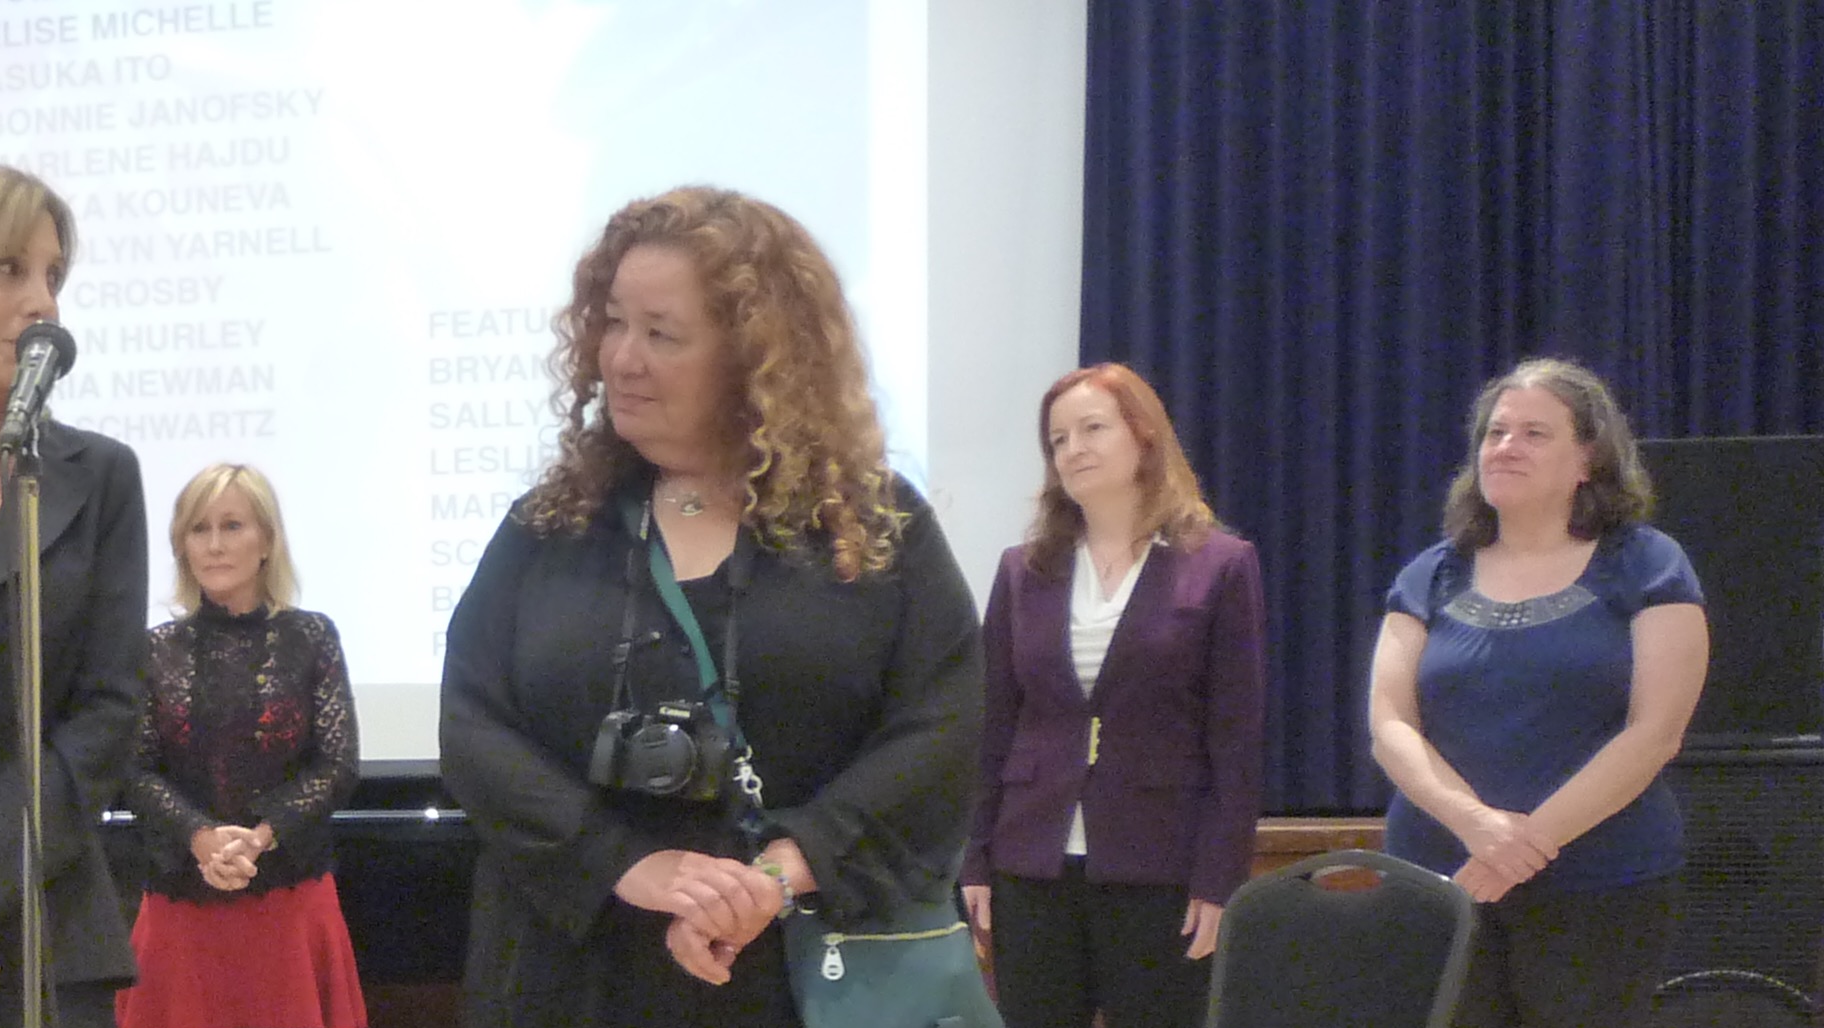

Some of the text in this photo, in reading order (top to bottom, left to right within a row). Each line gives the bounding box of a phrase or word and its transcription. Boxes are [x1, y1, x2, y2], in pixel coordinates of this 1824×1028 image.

[91, 0, 274, 41] MICHELLE
[114, 53, 172, 86] ITO
[128, 87, 324, 129] JANOFSKY
[167, 135, 292, 172] HAJDU
[116, 181, 292, 220] KOUNEVA
[165, 227, 333, 260] YARNELL
[73, 274, 224, 310] CROSBY
[120, 318, 266, 354] HURLEY
[428, 307, 547, 340] FEATU
[111, 363, 275, 398] NEWMAN
[429, 399, 549, 430] SALLY
